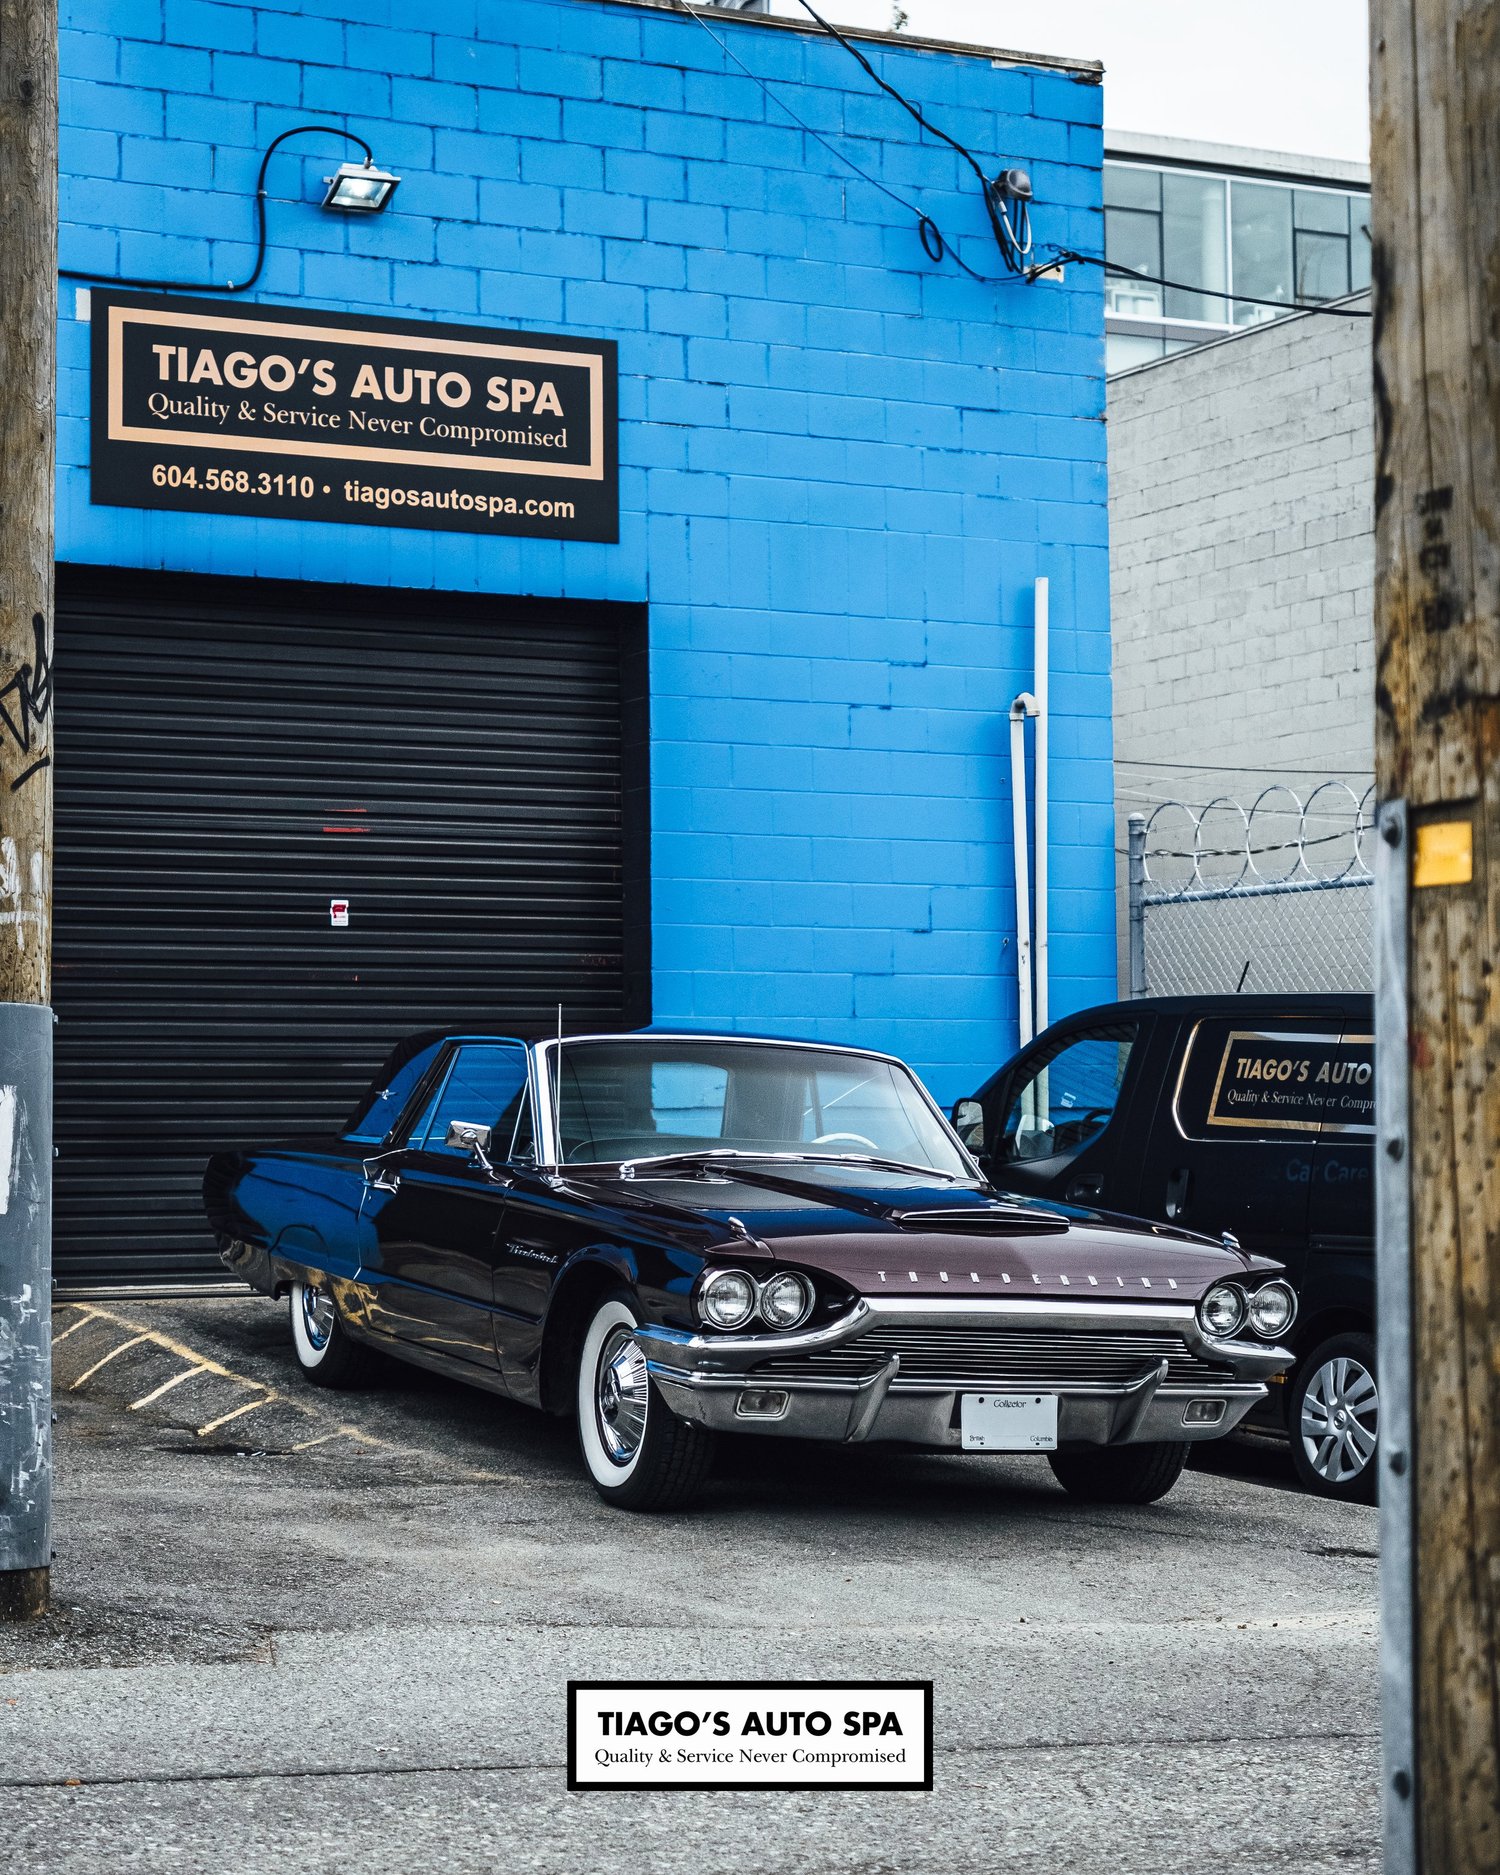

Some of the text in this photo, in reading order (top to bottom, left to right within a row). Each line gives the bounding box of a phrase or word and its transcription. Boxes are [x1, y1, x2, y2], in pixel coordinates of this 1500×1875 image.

[153, 345, 564, 416] TIAGO'S AUTO SPA
[148, 392, 568, 448] Quality & Service Never Compromised
[152, 464, 575, 518] 604.568.3110 tiagosautospa.com
[1236, 1058, 1372, 1085] TIAGO'S AUTO
[1227, 1089, 1260, 1106] Quality
[1261, 1091, 1270, 1102] &
[1271, 1091, 1304, 1105] Service
[1306, 1094, 1337, 1107] Never
[1285, 1158, 1369, 1184] Car Care
[993, 1400, 1027, 1408] Collector
